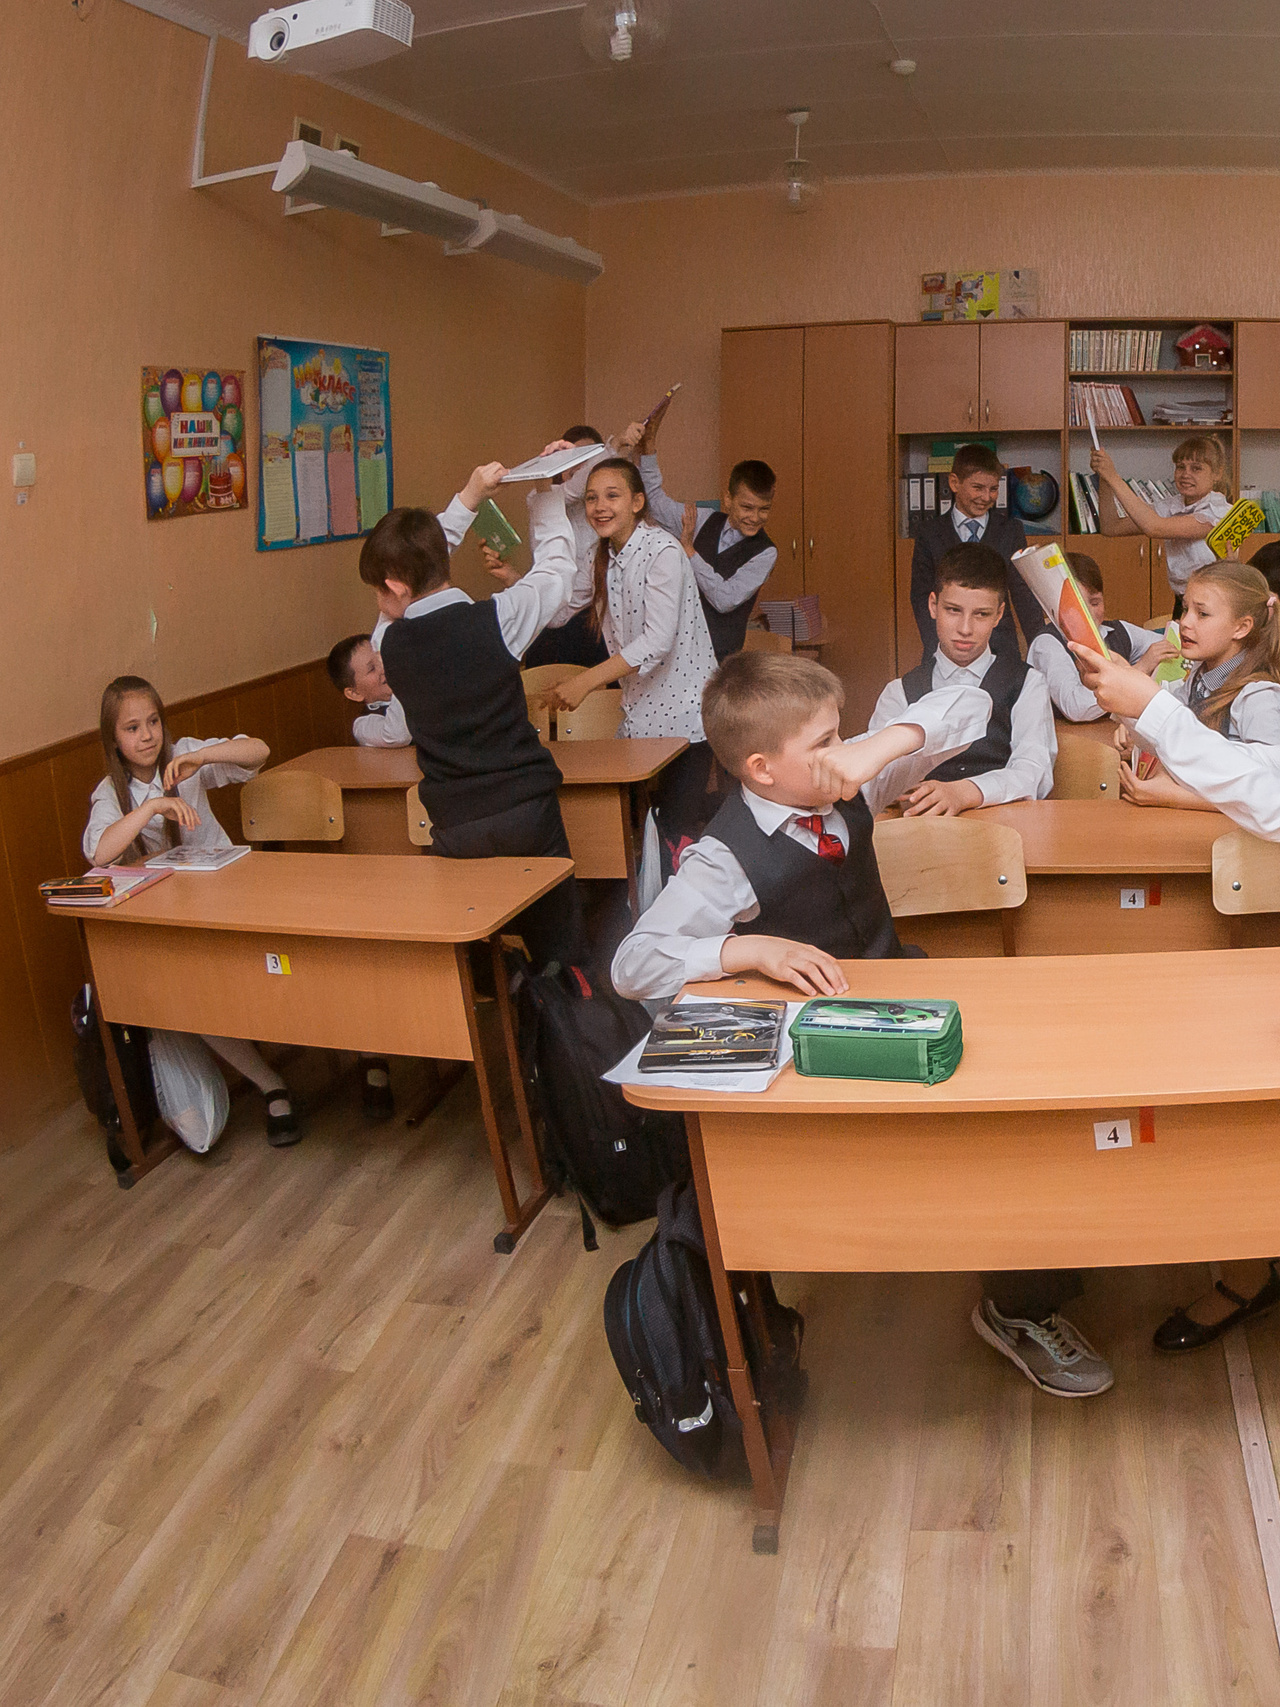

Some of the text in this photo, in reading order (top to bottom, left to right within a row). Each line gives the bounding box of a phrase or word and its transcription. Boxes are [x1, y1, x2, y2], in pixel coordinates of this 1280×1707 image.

[319, 375, 356, 403] КЛАСС
[180, 420, 213, 434] НАШИ
[1128, 893, 1137, 905] 4
[272, 956, 279, 969] 3
[1107, 1126, 1120, 1144] 4
